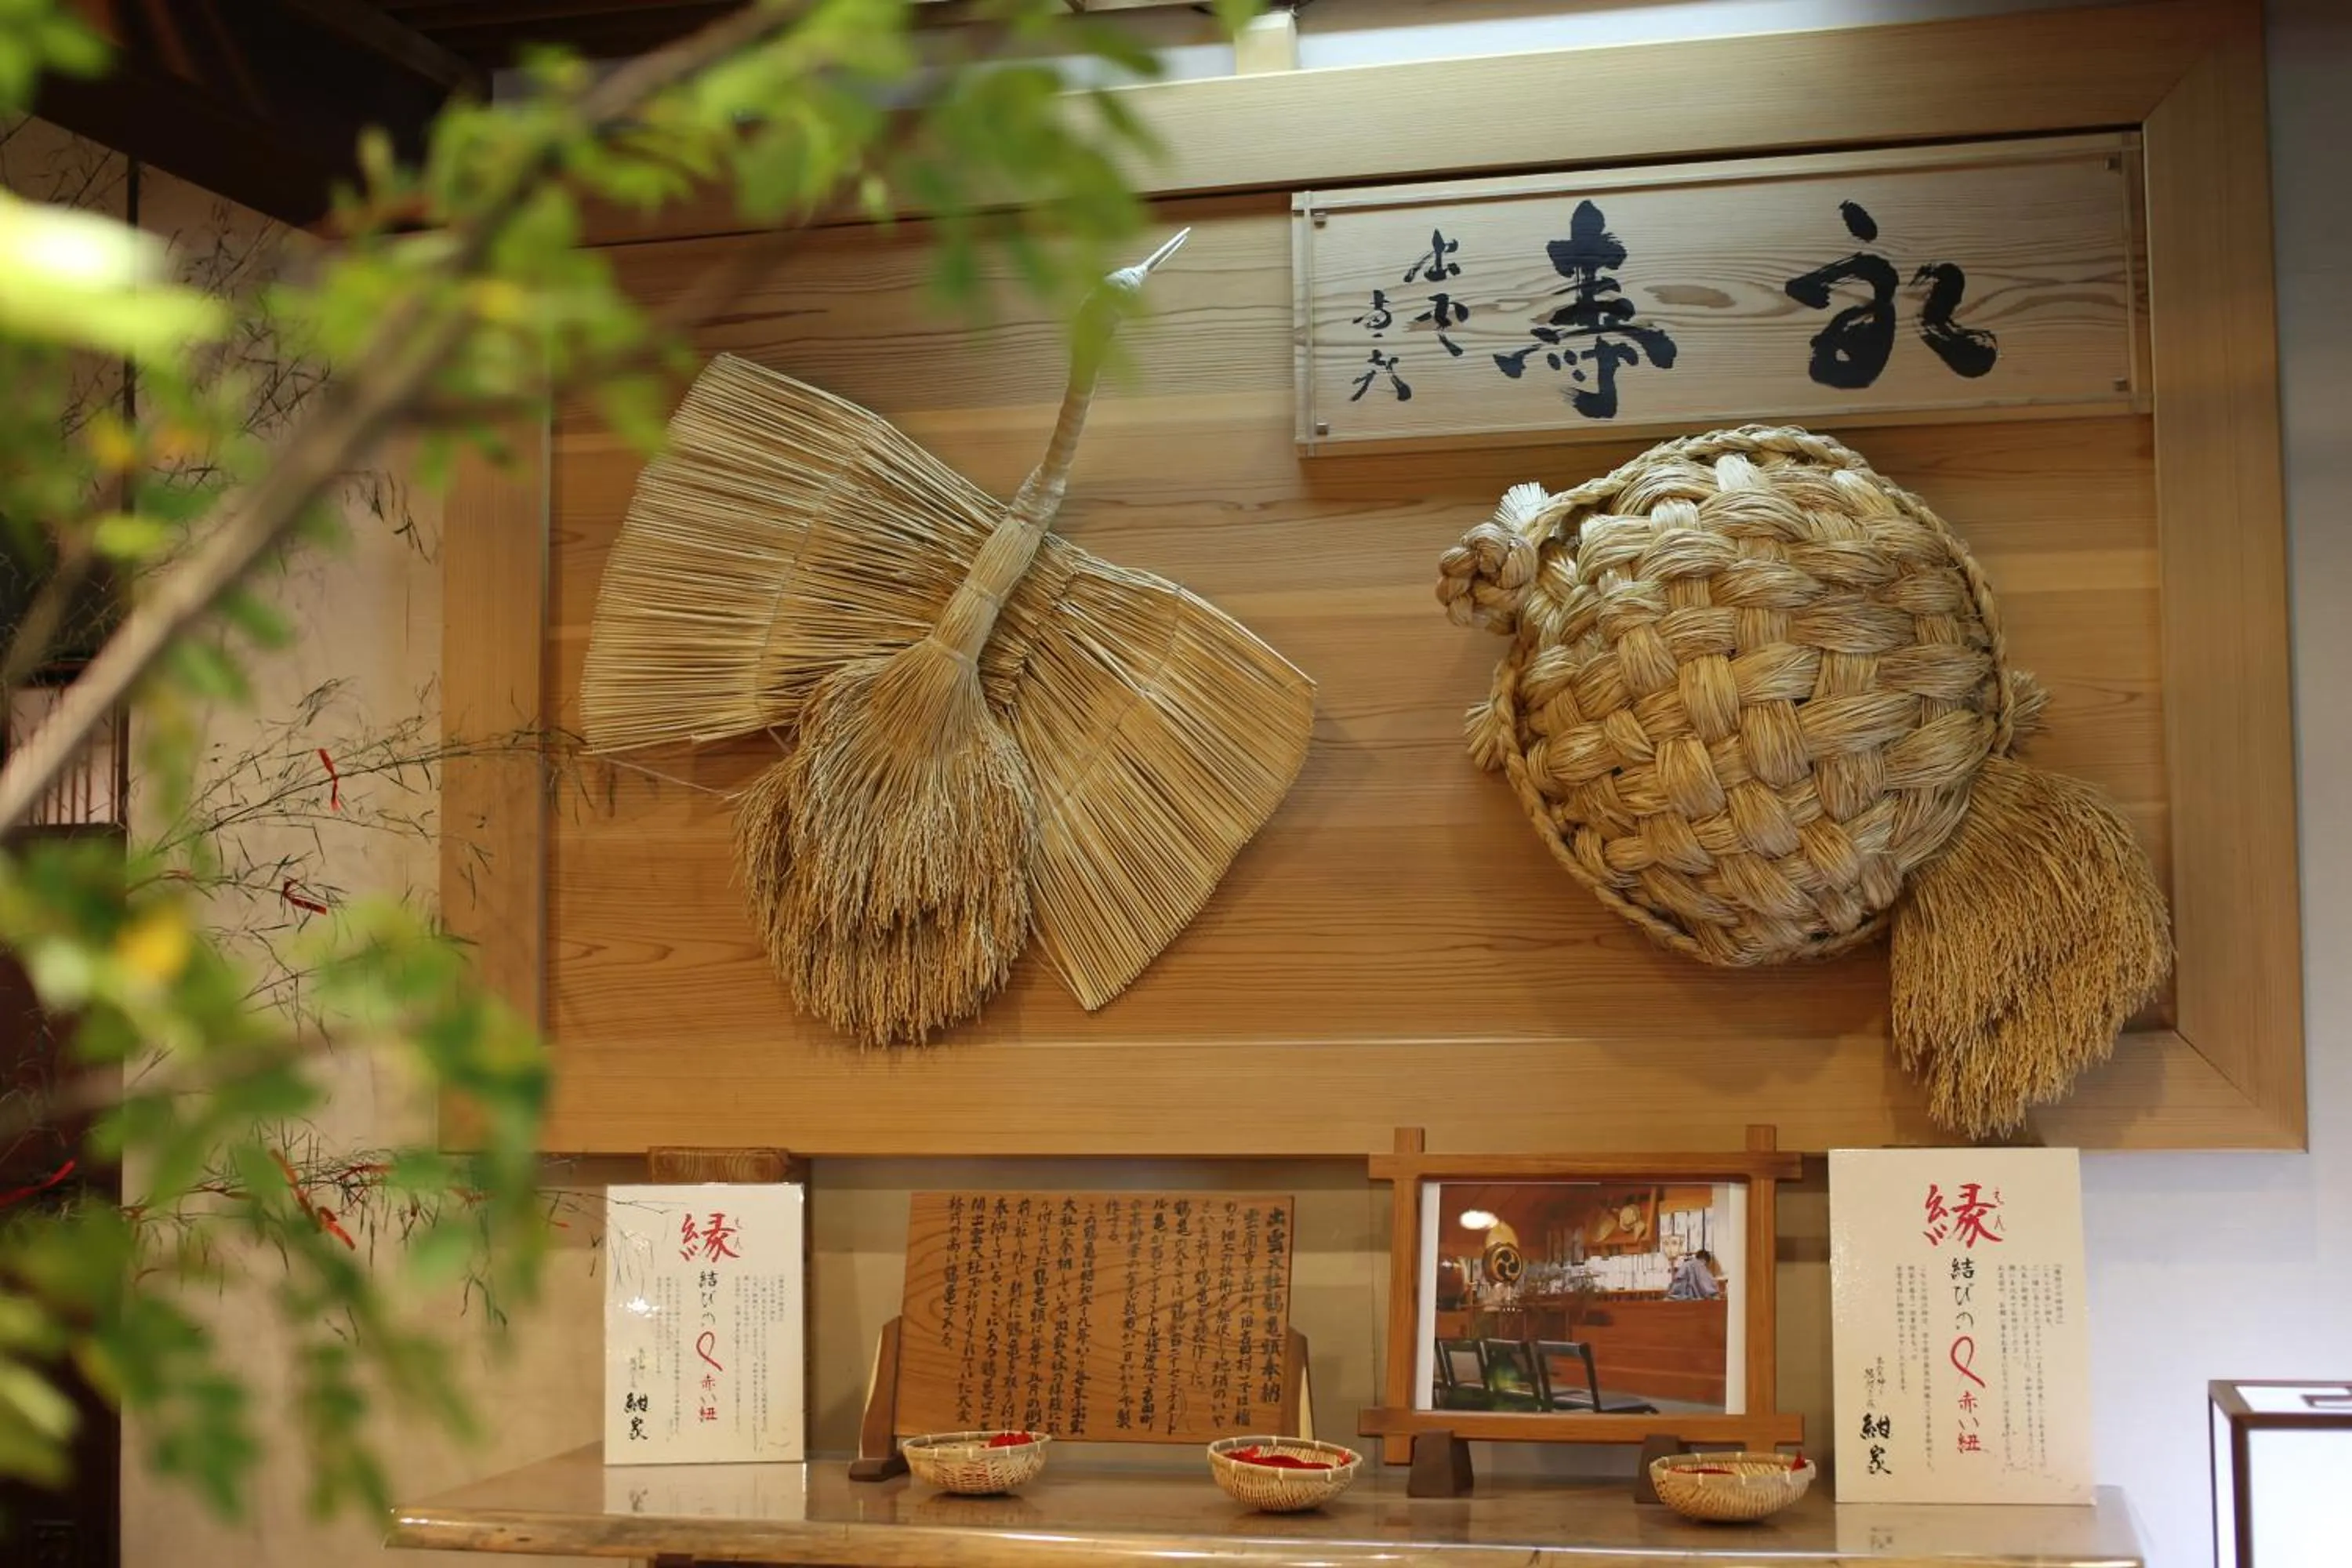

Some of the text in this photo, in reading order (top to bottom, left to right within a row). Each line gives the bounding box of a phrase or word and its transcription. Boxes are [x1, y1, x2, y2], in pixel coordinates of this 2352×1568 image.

[680, 1214, 740, 1262] 縁
[1923, 1183, 2003, 1249] 縁
[699, 1271, 719, 1327] 結びの
[1951, 1258, 1974, 1330] 結びの
[699, 1374, 718, 1422] 赤い紐
[1957, 1390, 1980, 1454] 赤い紐
